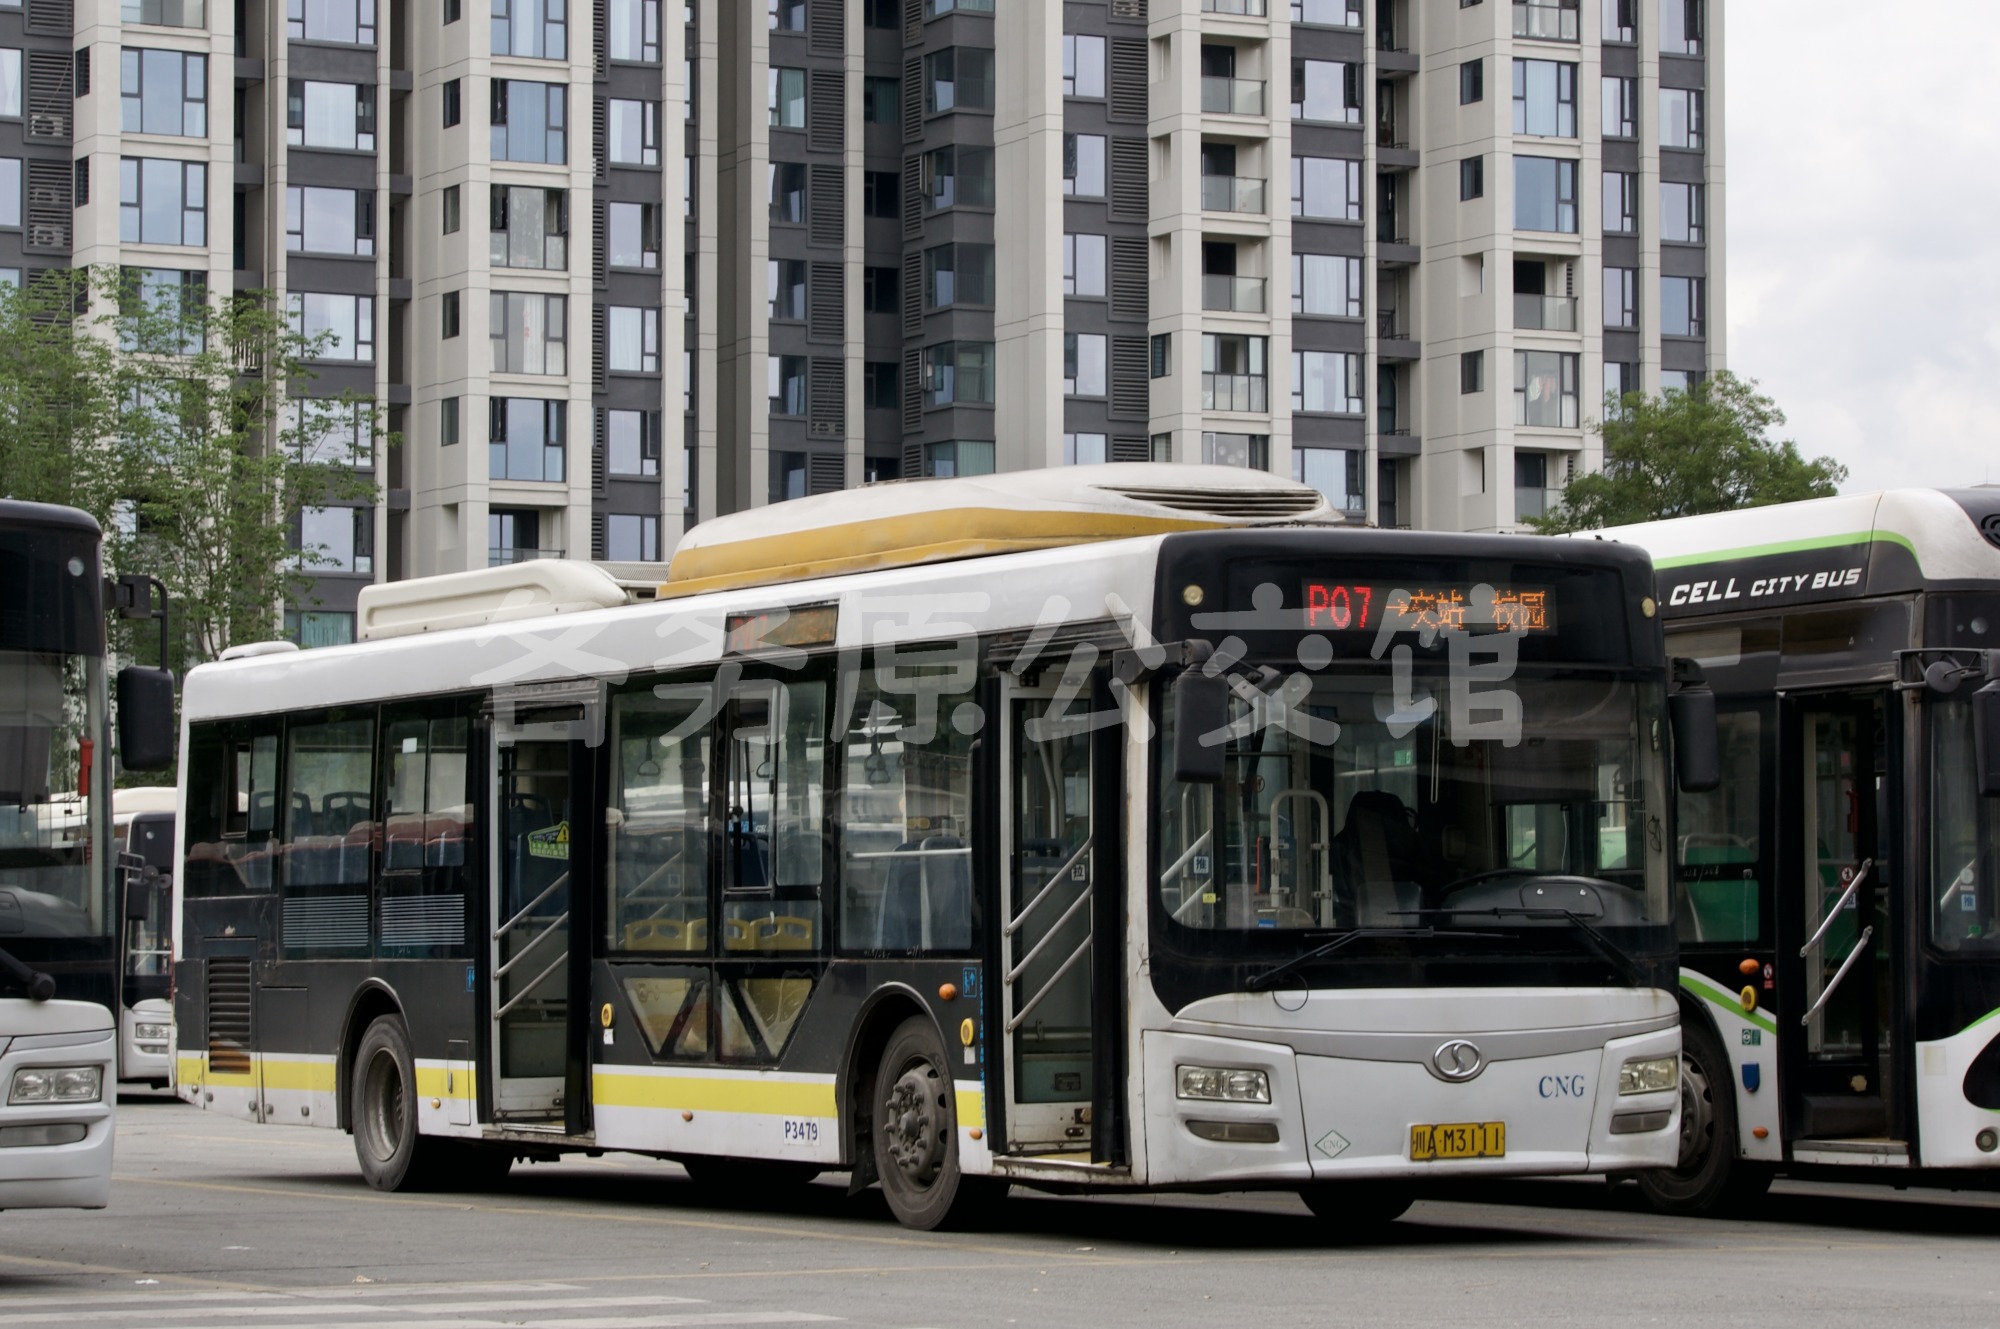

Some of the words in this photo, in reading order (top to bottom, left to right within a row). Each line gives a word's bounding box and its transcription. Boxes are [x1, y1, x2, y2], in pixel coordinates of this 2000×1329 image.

[1669, 578, 1741, 606] CELL
[1750, 573, 1810, 597] CITY
[1811, 567, 1863, 590] BUS
[1308, 584, 1371, 628] P07
[1538, 1075, 1585, 1098] CNG
[785, 1120, 818, 1141] P3479
[1323, 1139, 1343, 1150] CNG
